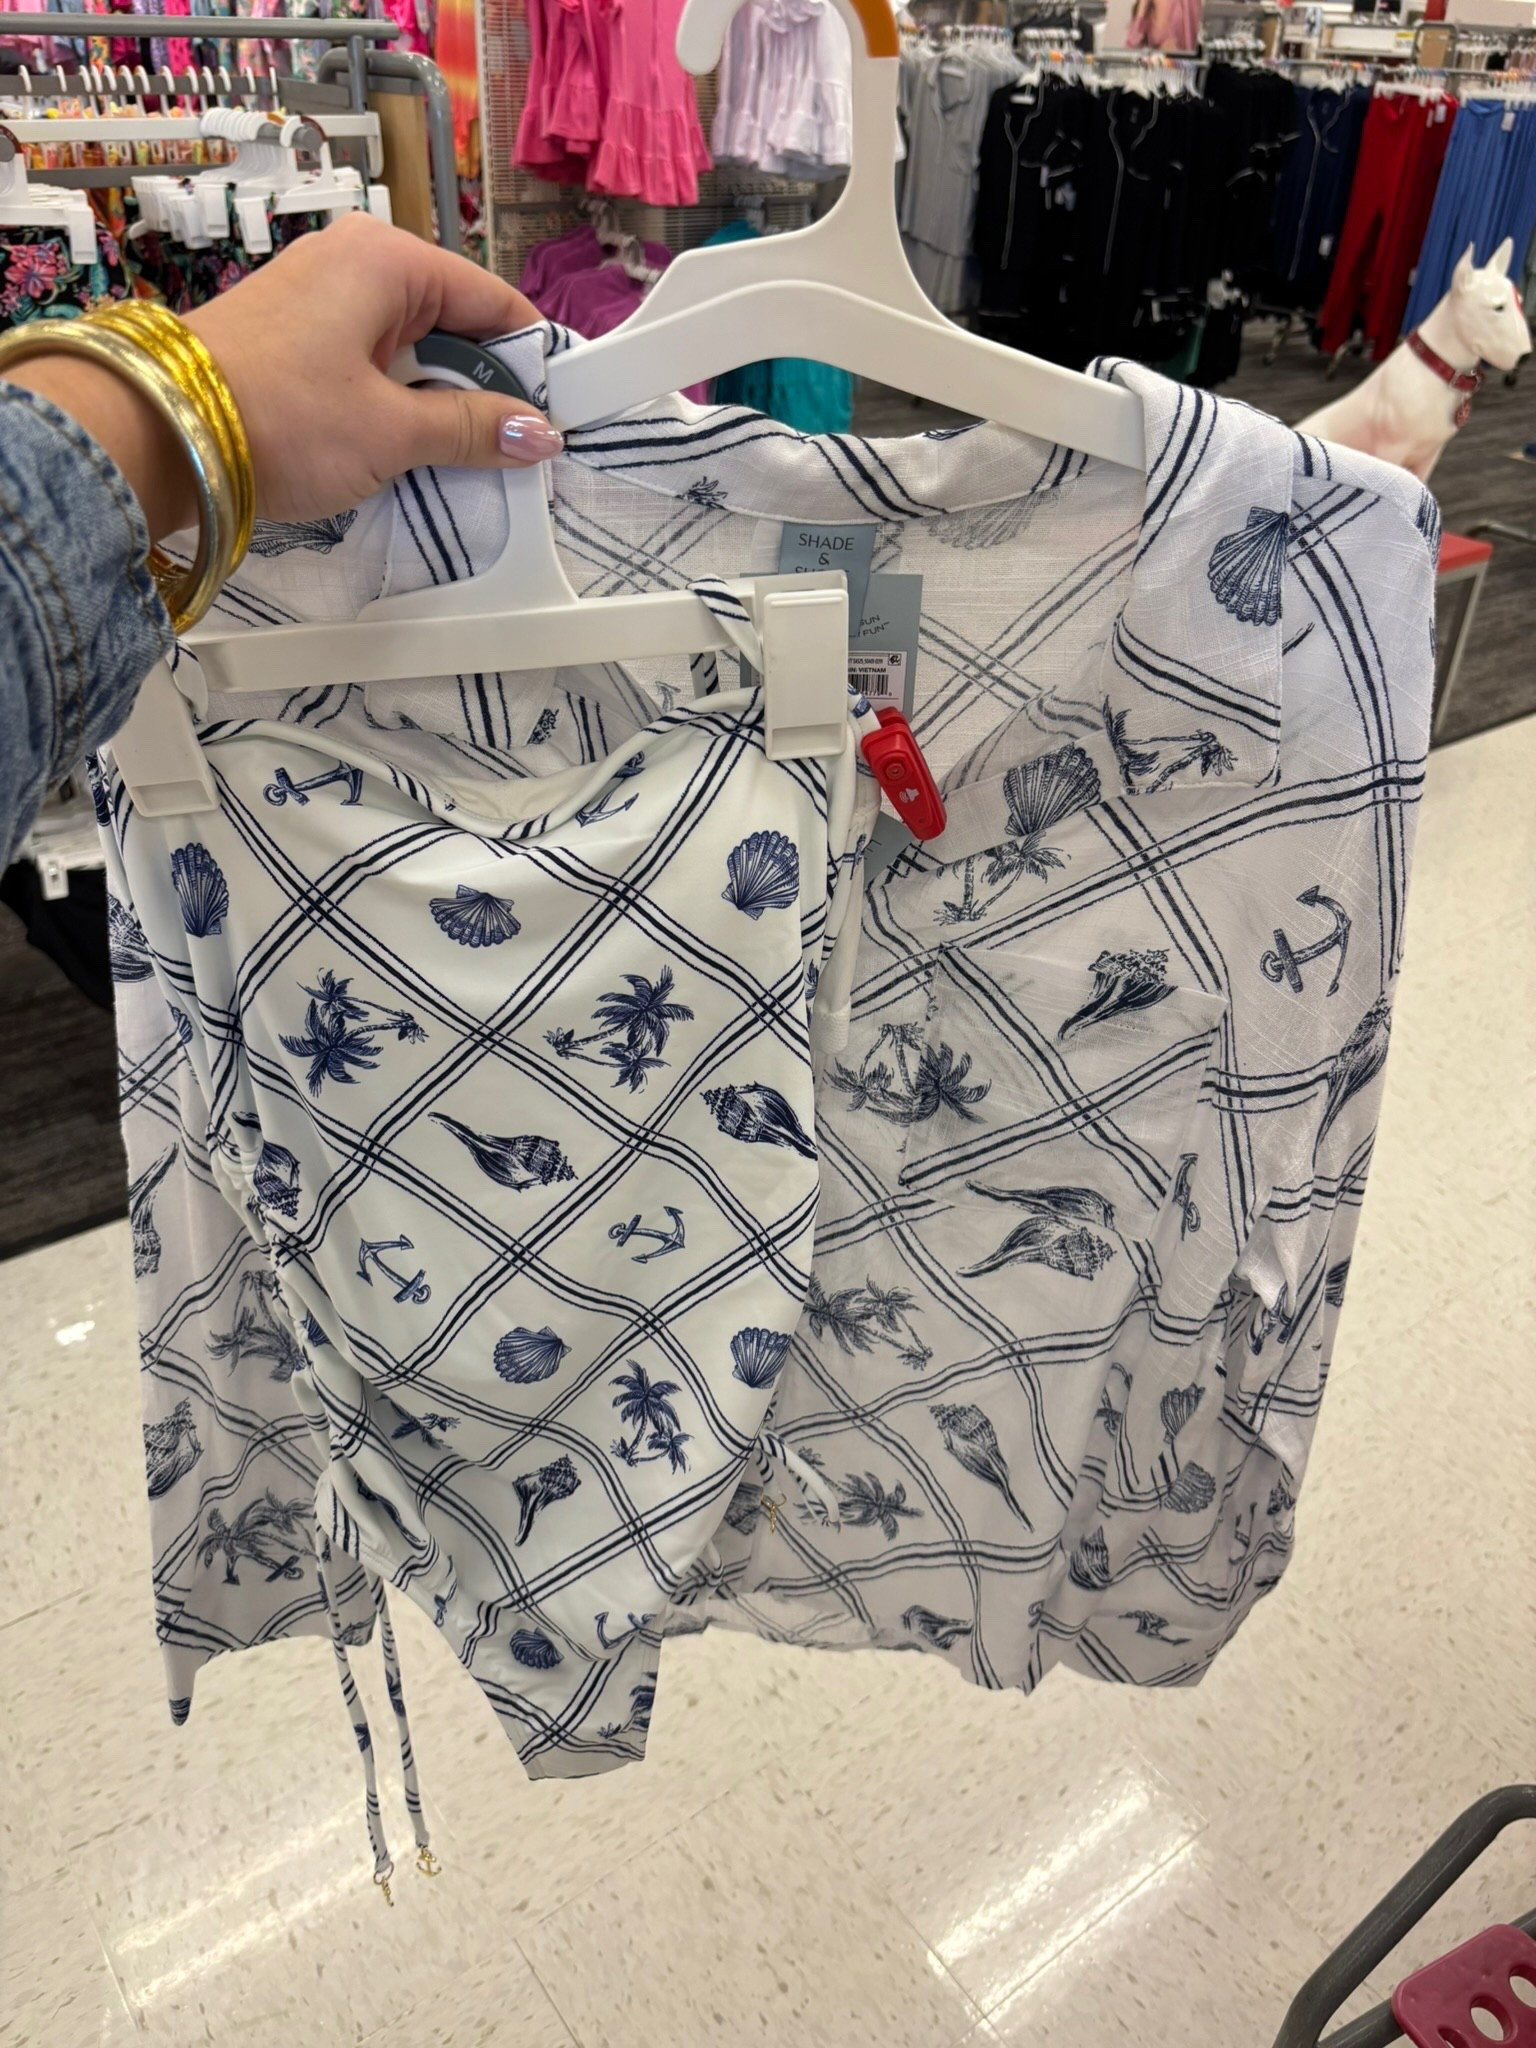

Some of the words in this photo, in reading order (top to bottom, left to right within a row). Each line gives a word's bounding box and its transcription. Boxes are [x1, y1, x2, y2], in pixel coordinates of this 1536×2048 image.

[473, 361, 495, 384] M
[798, 533, 855, 551] SHADE
[818, 552, 830, 566] &
[860, 614, 880, 626] SUN
